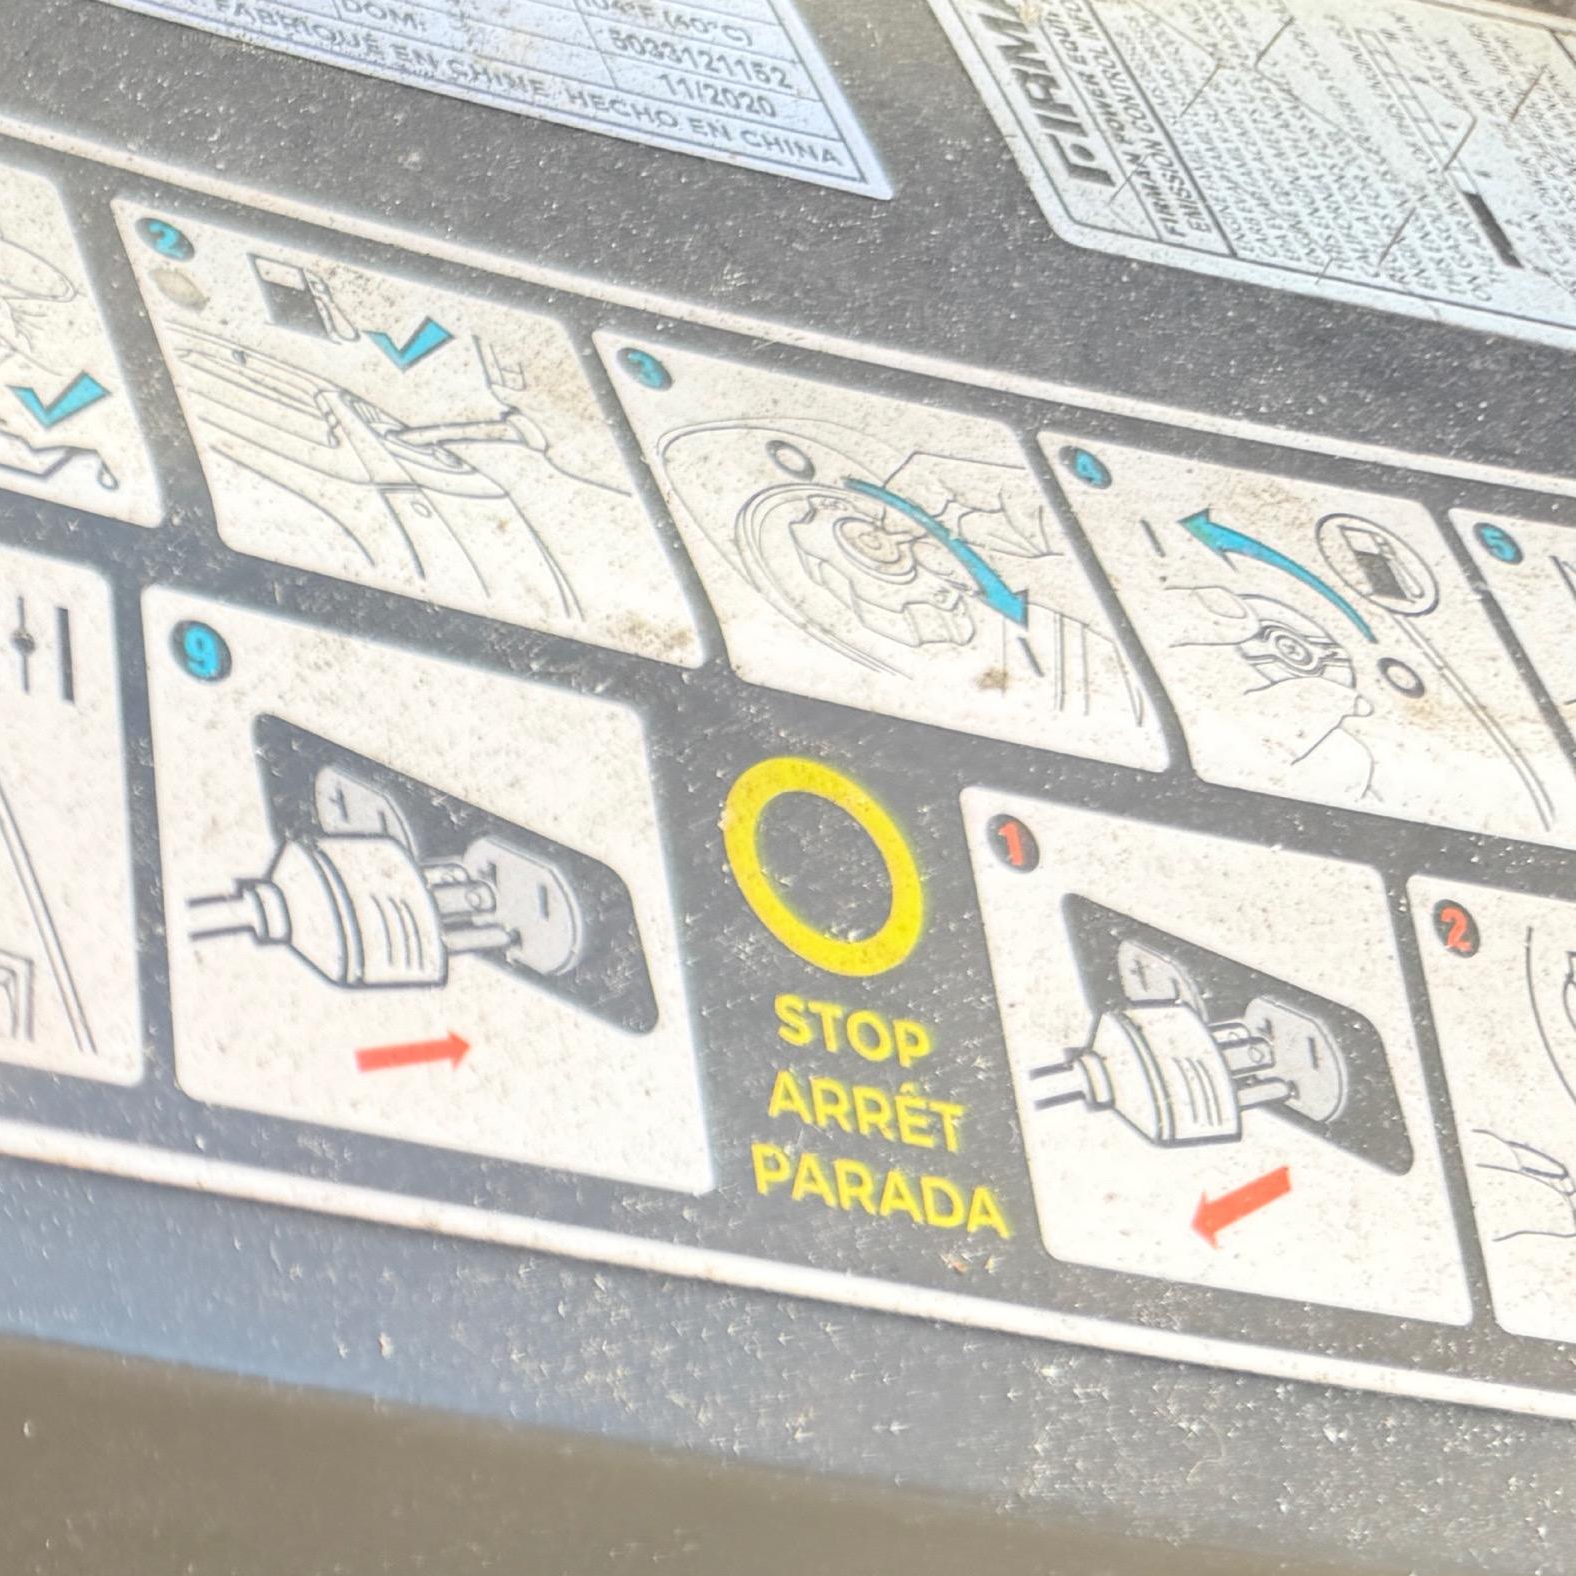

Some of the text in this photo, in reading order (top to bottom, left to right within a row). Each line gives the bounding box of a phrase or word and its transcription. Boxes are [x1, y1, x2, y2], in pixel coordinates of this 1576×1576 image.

[564, 87, 678, 129] HECHO
[689, 117, 731, 143] EN
[739, 127, 845, 167] CHINA
[658, 73, 777, 118] 11/2020
[1076, 70, 1136, 147] POWER
[1091, 45, 1156, 134] CONTROL
[1121, 150, 1188, 238] FIRMAN
[1141, 138, 1213, 234] EMISSION
[145, 218, 189, 257] 2
[1483, 524, 1515, 563] 5
[186, 627, 220, 678] 9
[998, 819, 1029, 868] 1
[1440, 904, 1474, 951] 2
[773, 991, 935, 1069] STOP
[766, 1070, 967, 1155] ARRÊT
[750, 1142, 1013, 1241] PARADA
